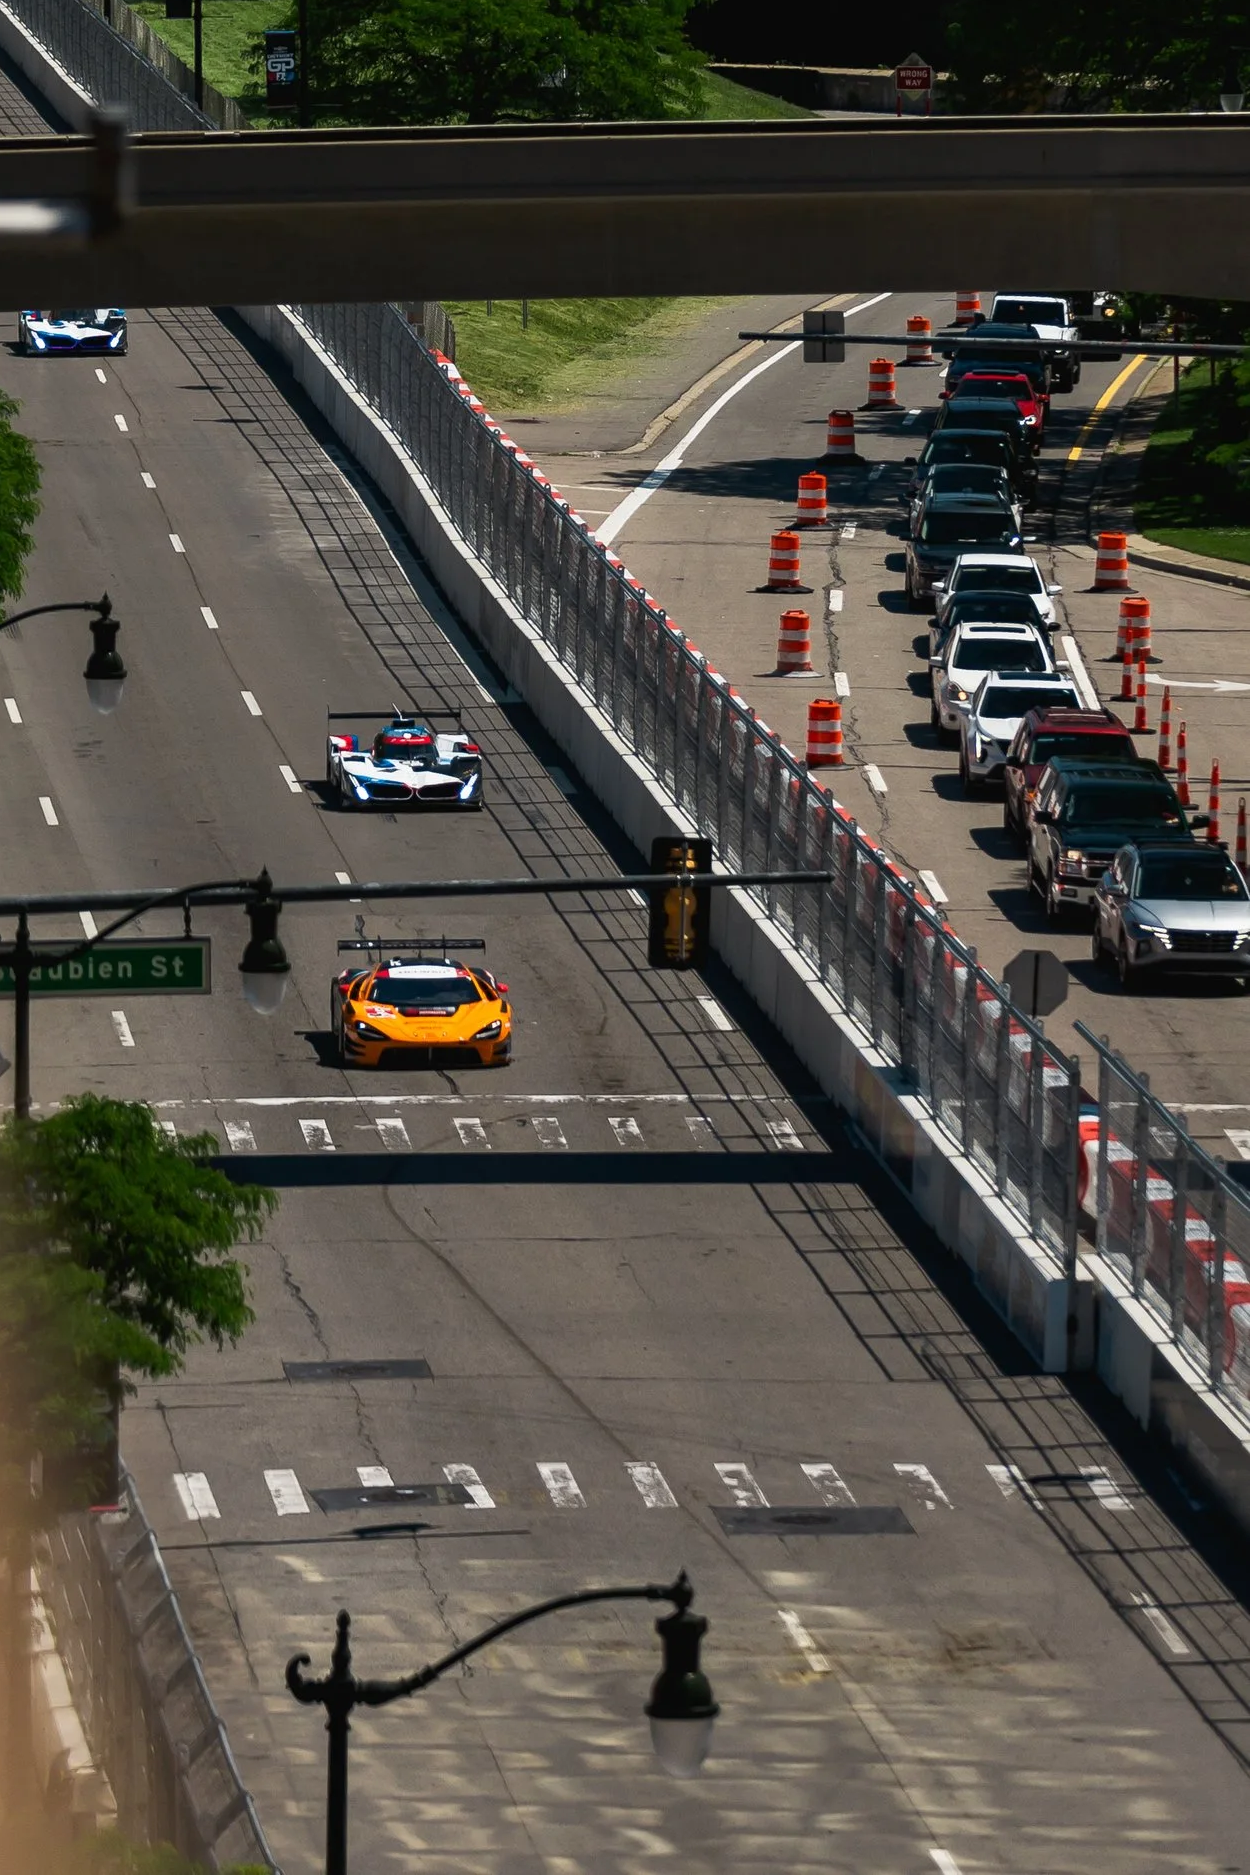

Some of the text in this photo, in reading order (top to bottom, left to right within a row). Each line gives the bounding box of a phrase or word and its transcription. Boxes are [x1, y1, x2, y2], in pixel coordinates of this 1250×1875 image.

[267, 58, 295, 72] GP
[899, 70, 928, 78] WRONG
[150, 955, 185, 978] St
